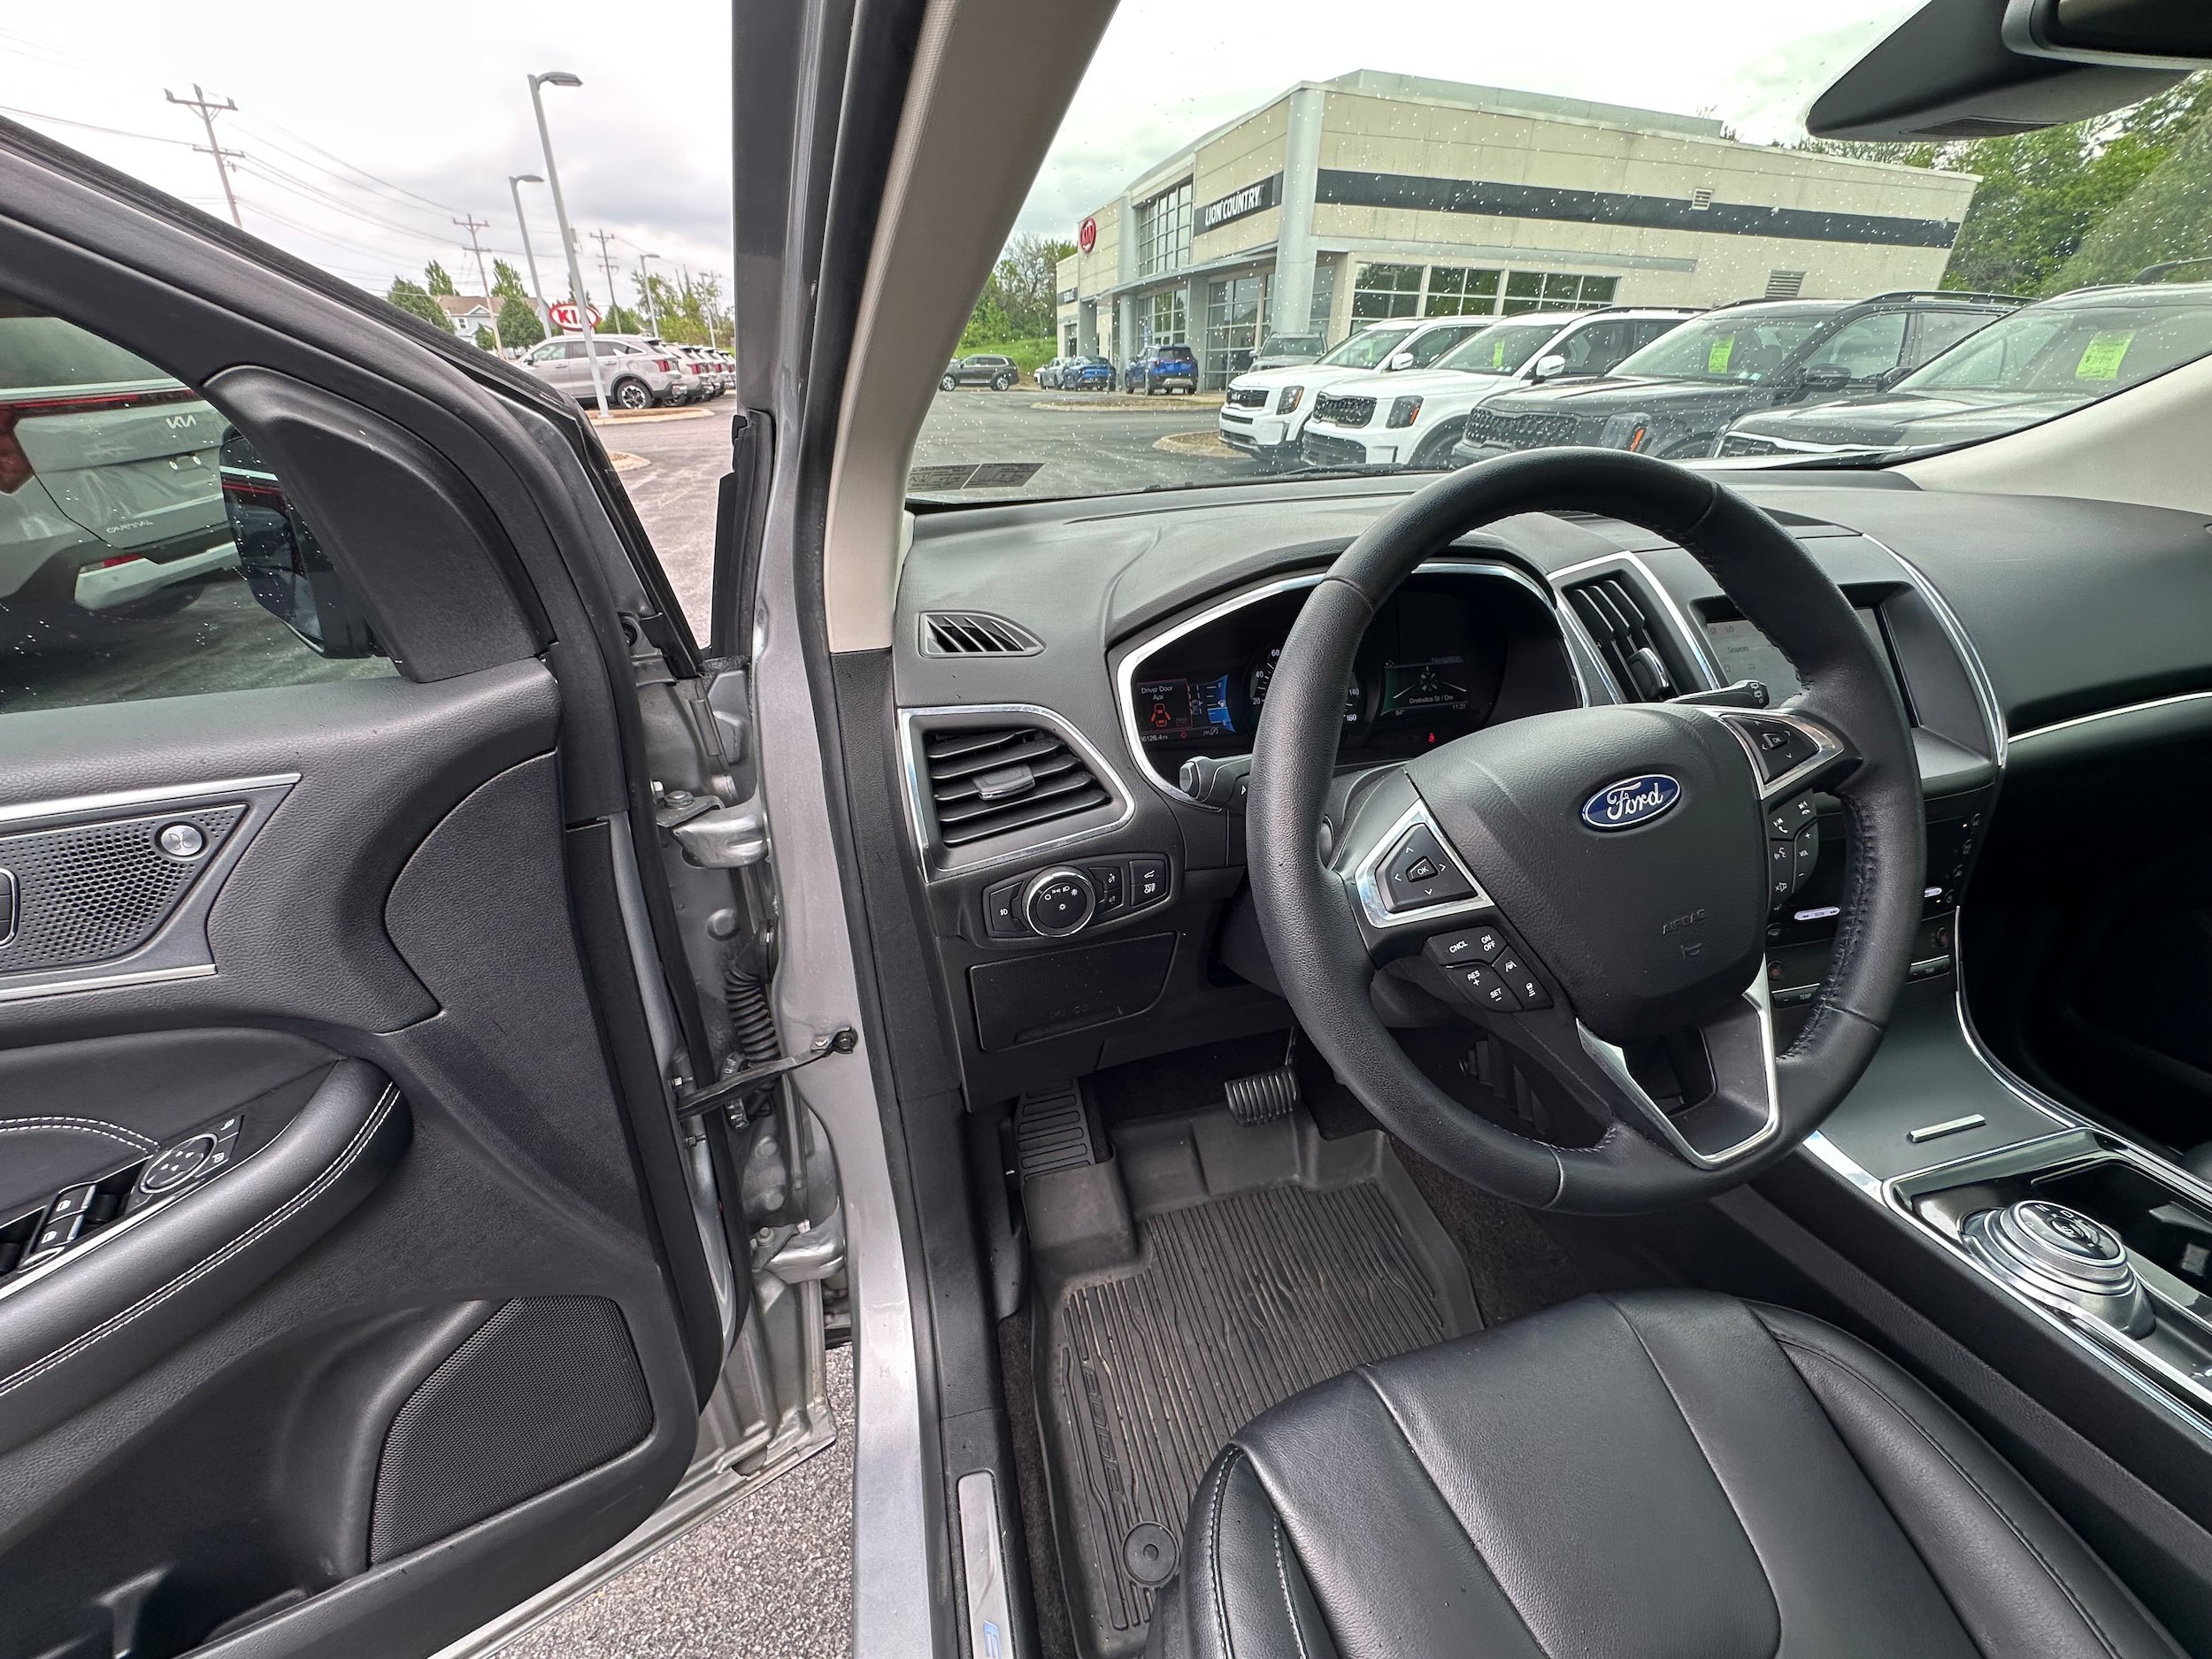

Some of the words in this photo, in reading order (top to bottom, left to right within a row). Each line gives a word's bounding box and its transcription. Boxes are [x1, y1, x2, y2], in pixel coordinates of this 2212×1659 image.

[1205, 202, 1222, 227] LION
[1223, 185, 1261, 219] COUNTRY
[1271, 649, 1280, 657] 60
[1346, 713, 1357, 722] 160
[1606, 781, 1663, 821] Ford
[1417, 865, 1430, 876] OK
[1480, 934, 1493, 944] ON
[1448, 940, 1469, 954] CNCL
[1483, 941, 1496, 952] OFF
[1466, 970, 1481, 981] RES
[1489, 987, 1502, 999] SET
